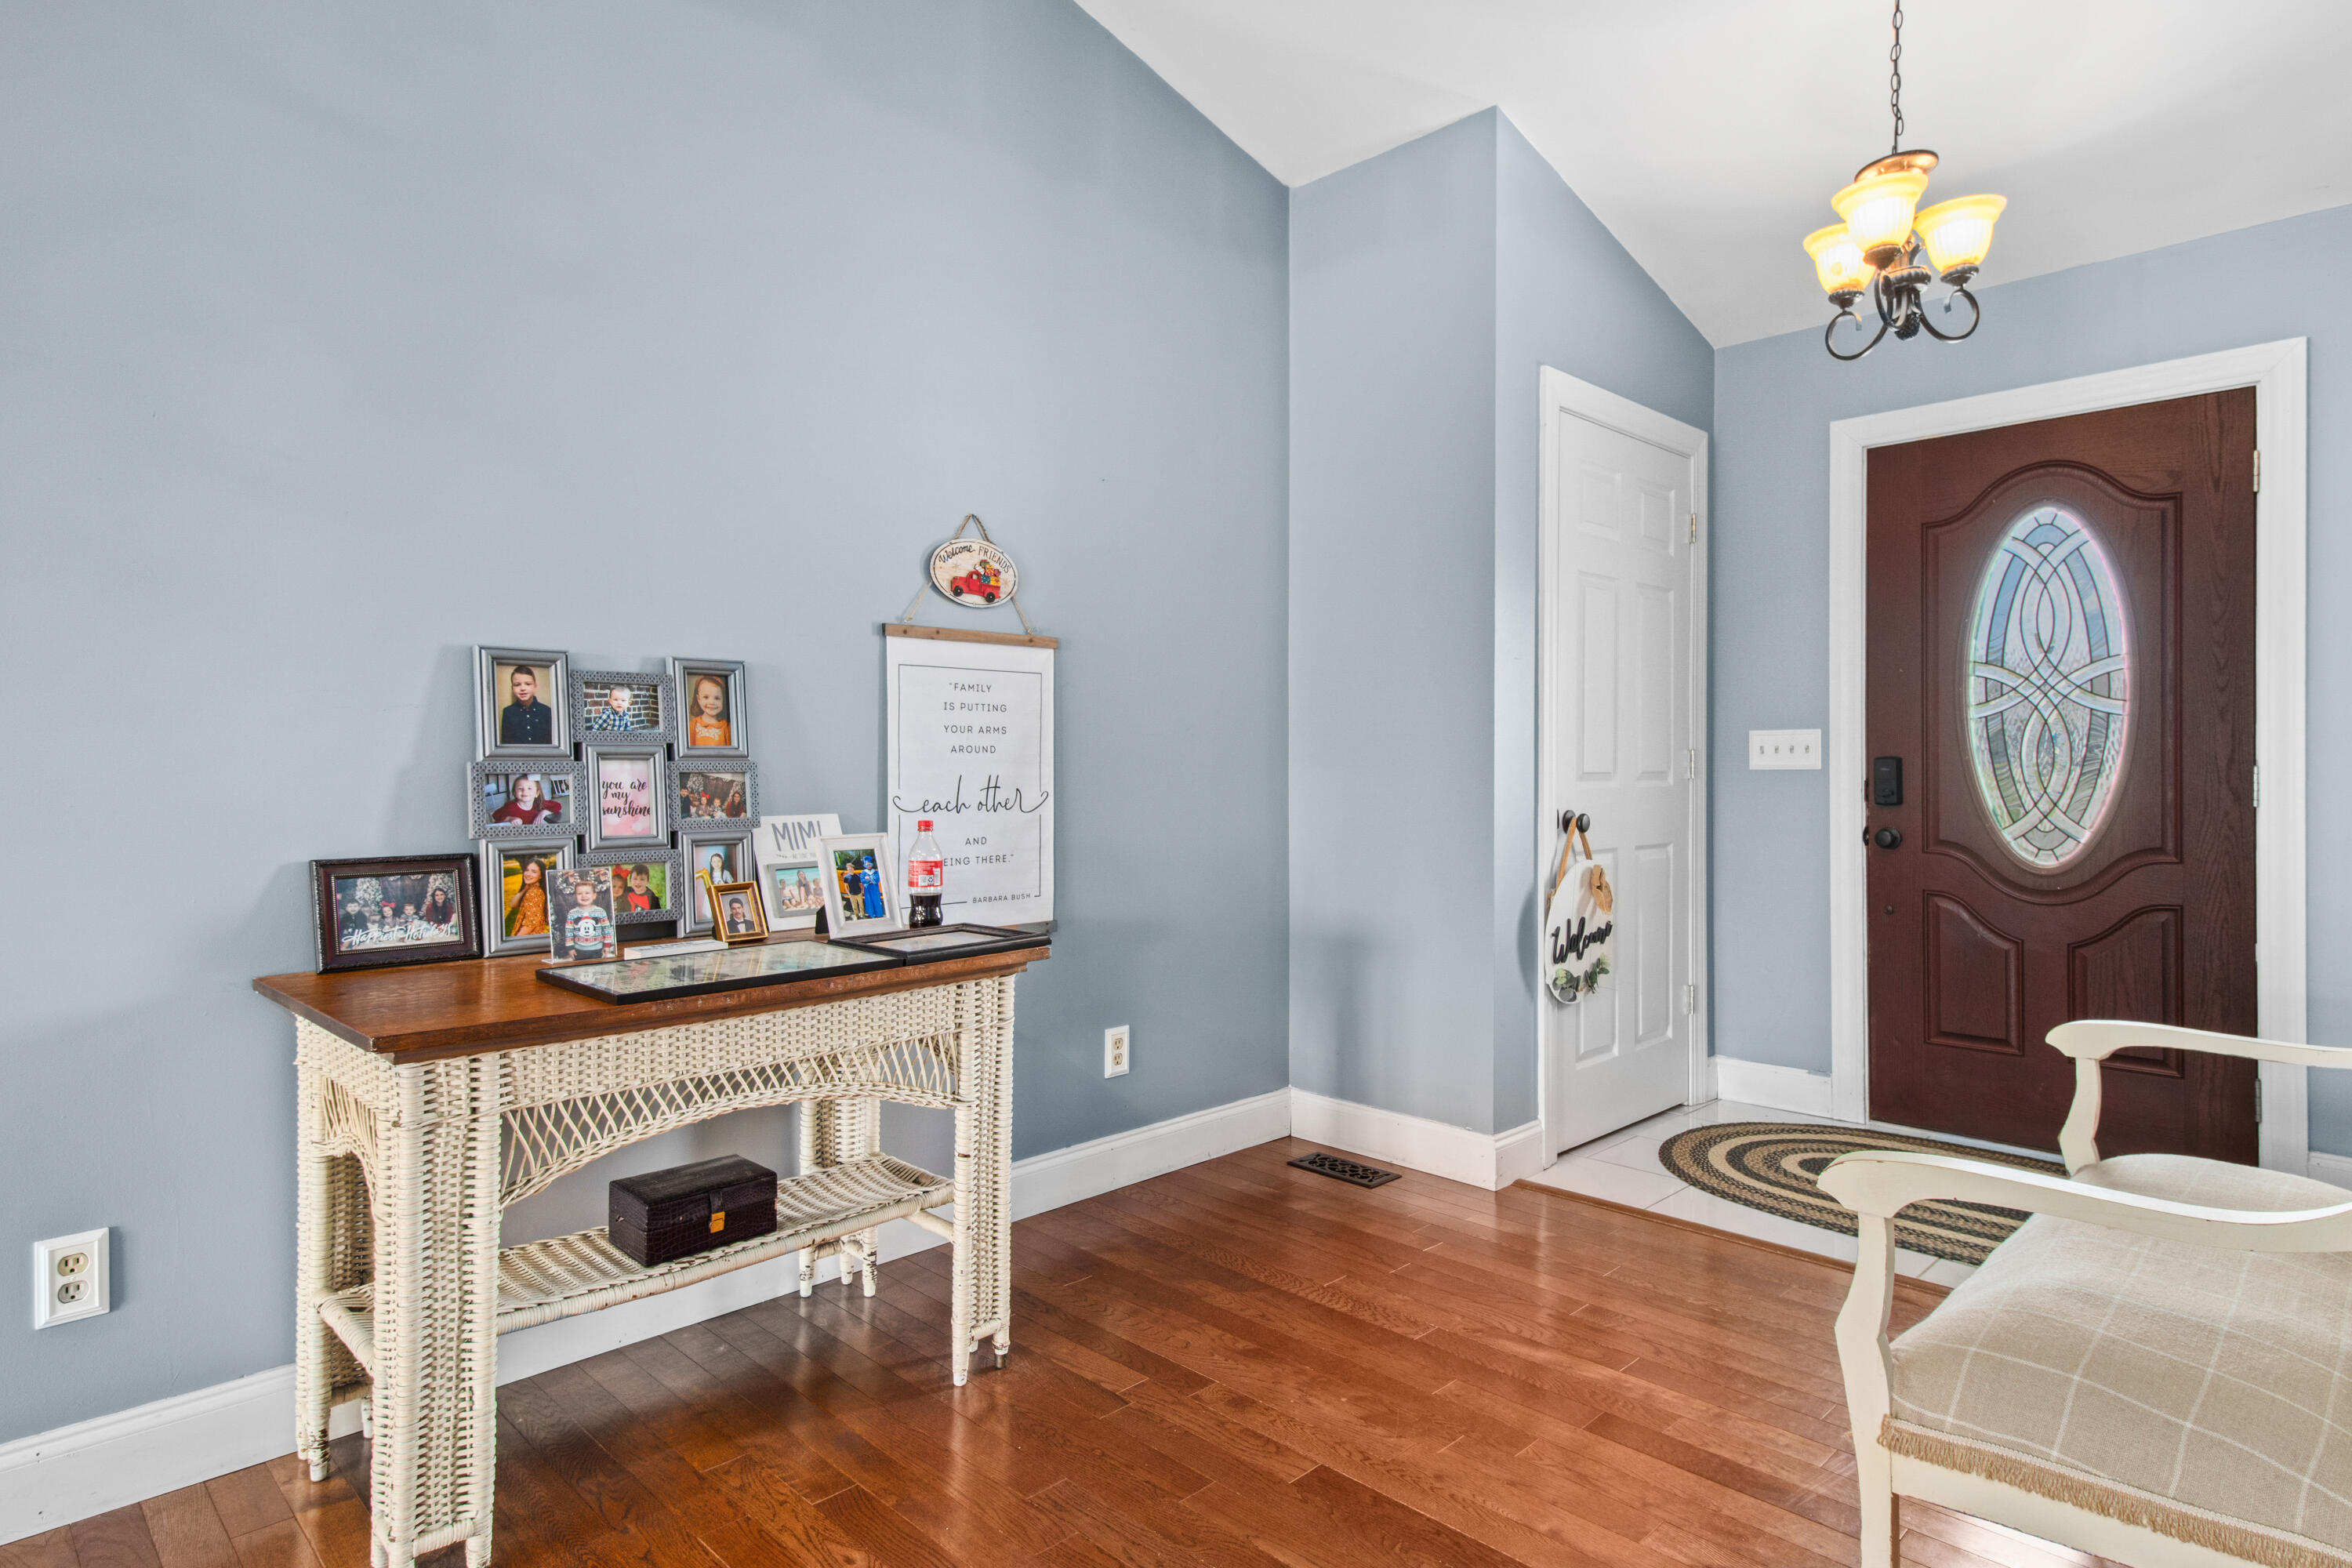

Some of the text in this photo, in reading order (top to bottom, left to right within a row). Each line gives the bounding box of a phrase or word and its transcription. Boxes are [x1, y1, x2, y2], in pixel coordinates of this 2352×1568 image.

[938, 545, 1011, 573] Welcome FRIENDS
[944, 702, 1007, 713] IS PUTTING
[943, 724, 1007, 735] YOUR ARMS
[950, 745, 996, 753] AROUND
[602, 779, 647, 800] you are
[892, 775, 1049, 814] each other
[612, 791, 630, 805] my
[965, 837, 987, 846] AND
[943, 857, 971, 866] EING
[972, 893, 1031, 904] BARBARA BUSH
[343, 921, 453, 946] Happiest Holidays
